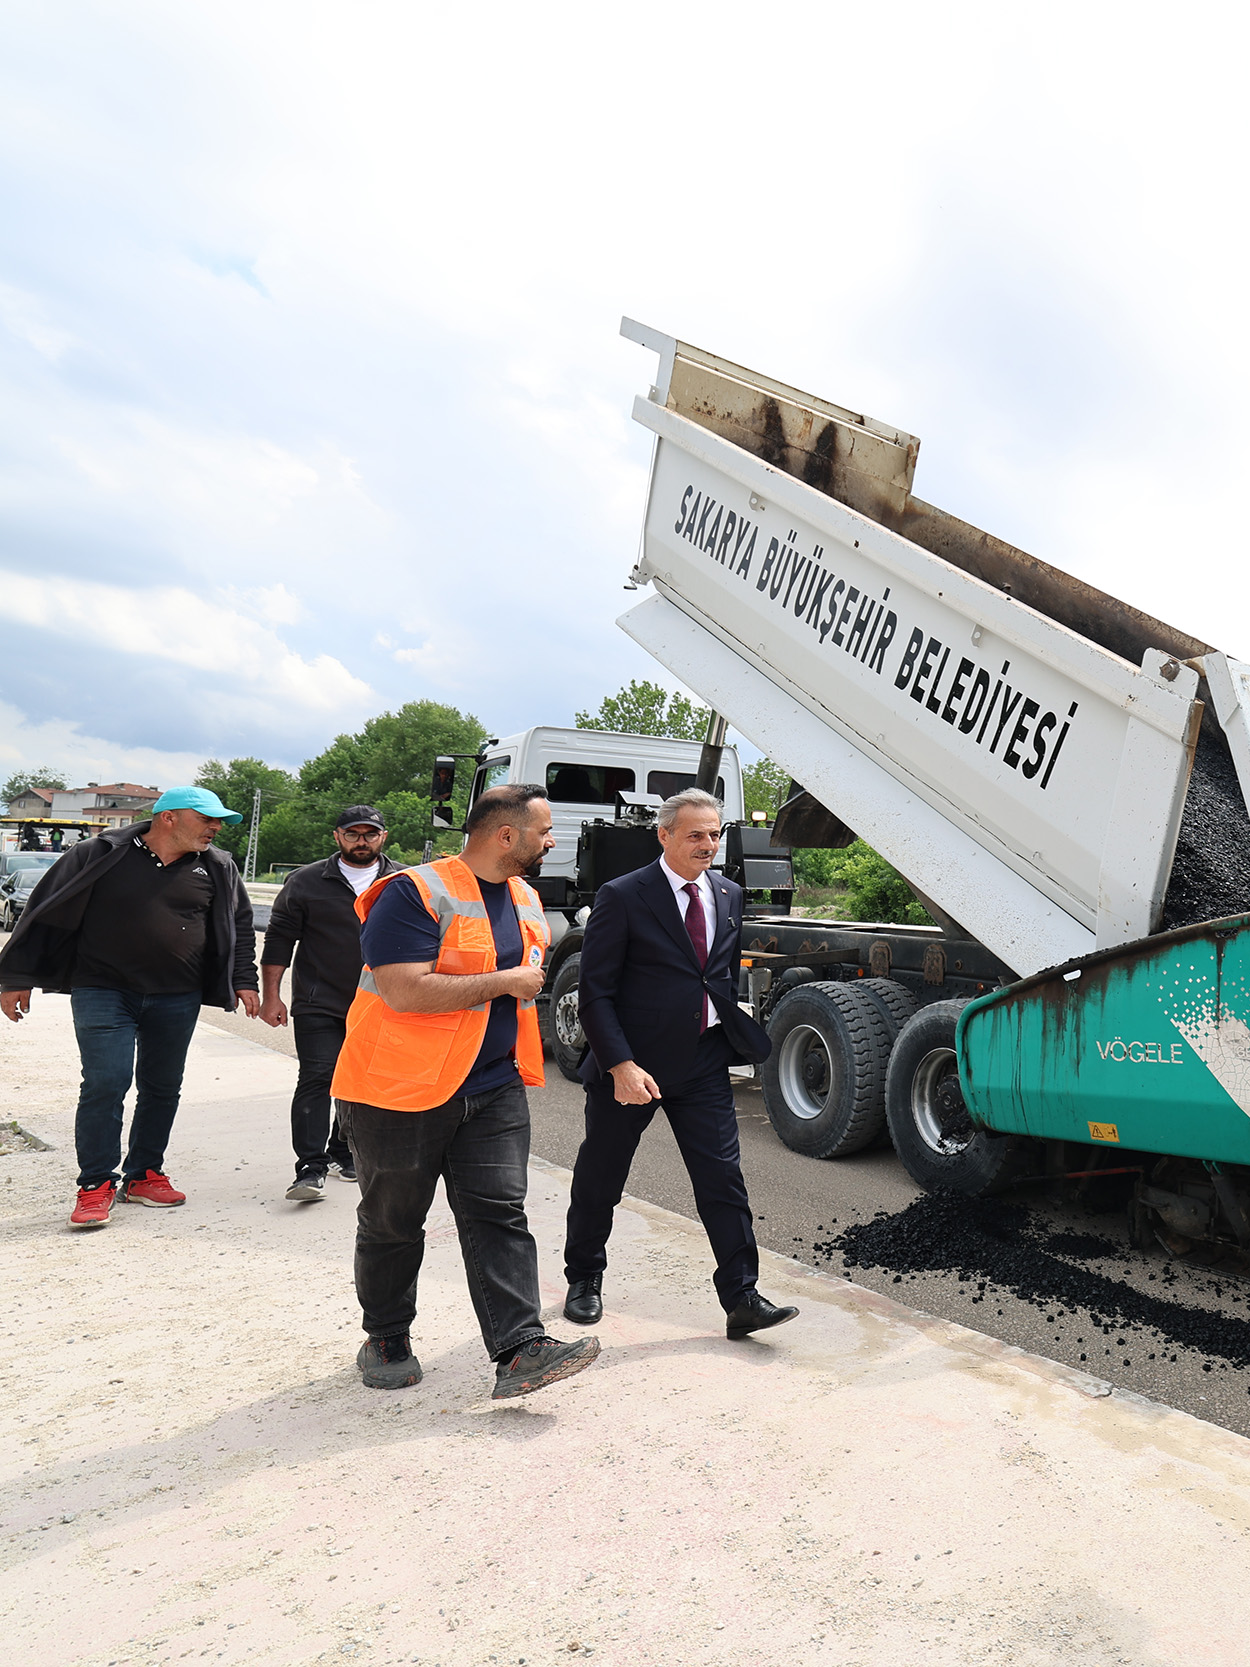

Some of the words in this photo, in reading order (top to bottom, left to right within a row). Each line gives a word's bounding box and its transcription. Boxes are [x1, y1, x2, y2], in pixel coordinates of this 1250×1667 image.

[674, 484, 759, 581] SAKARYA
[755, 528, 898, 676] BÜYÜKŞEHİR
[893, 626, 1079, 790] BELEDİYESİ
[1096, 1036, 1184, 1064] VÖGELE
